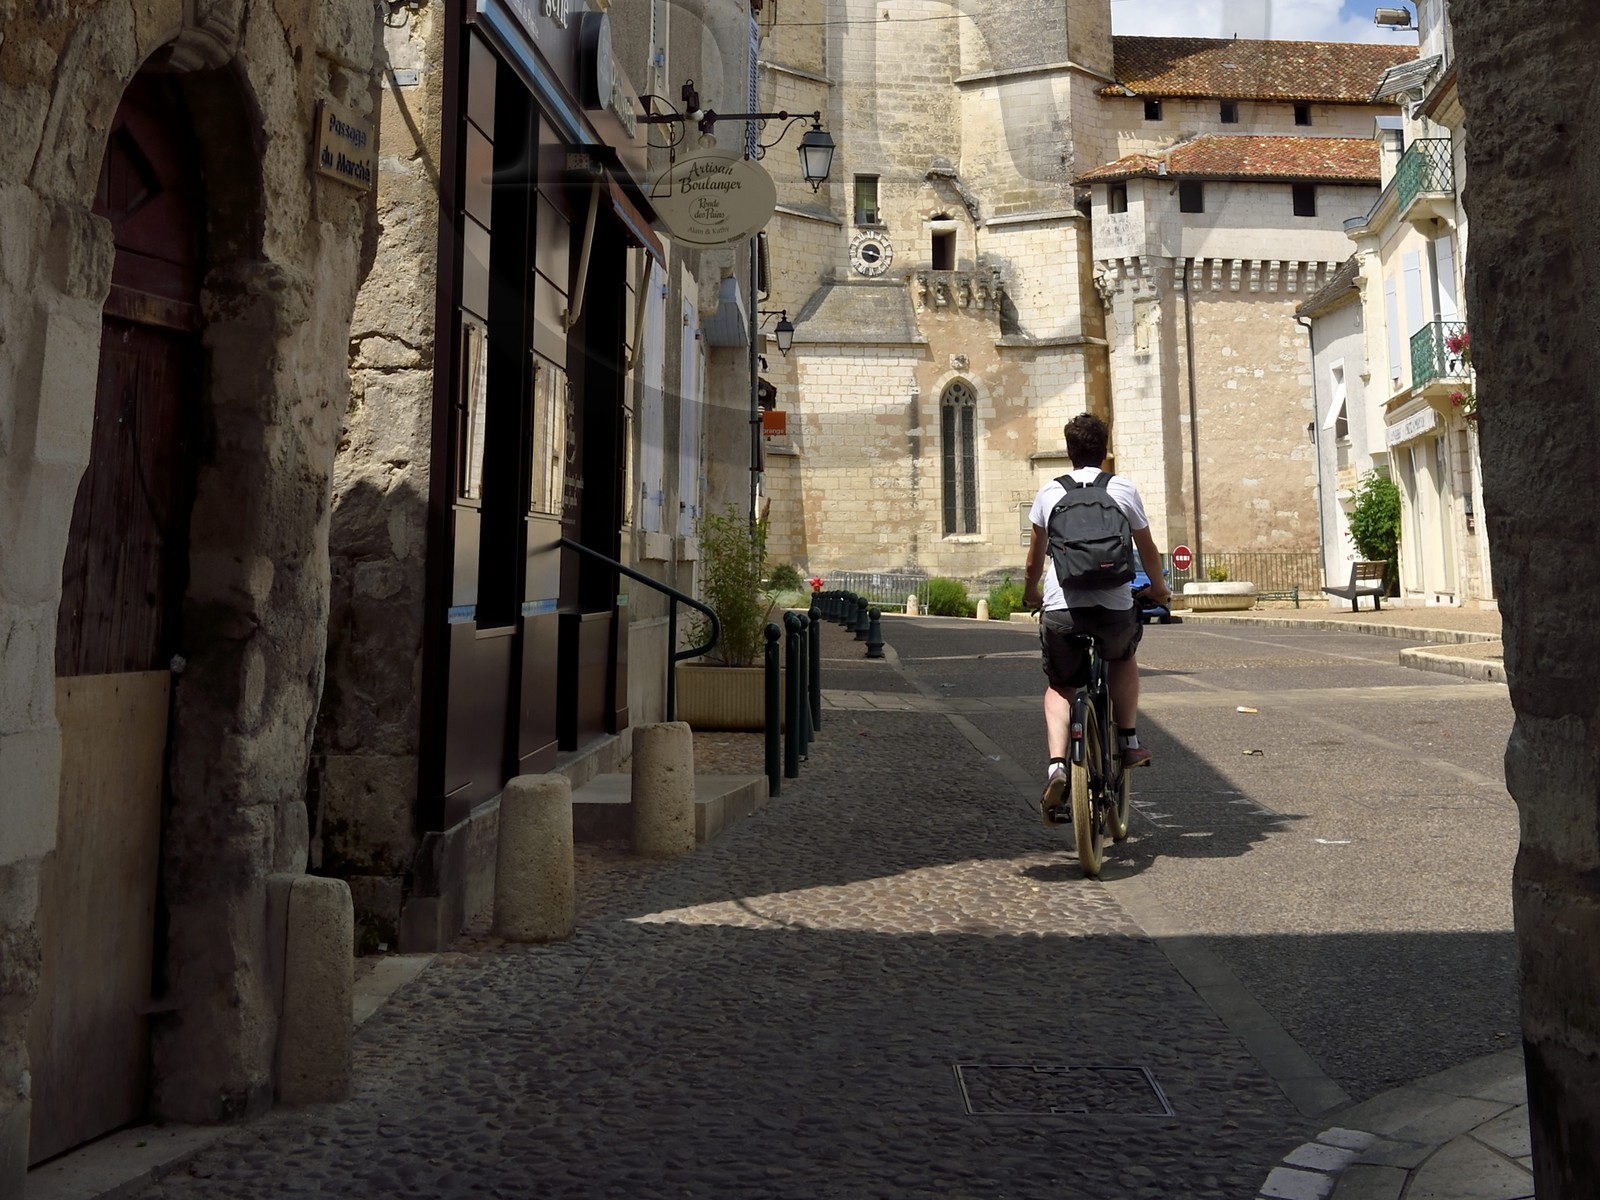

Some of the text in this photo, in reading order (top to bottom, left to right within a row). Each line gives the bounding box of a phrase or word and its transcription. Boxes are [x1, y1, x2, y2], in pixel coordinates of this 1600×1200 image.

[329, 113, 367, 148] Passage
[322, 145, 371, 182] du Marché
[689, 161, 733, 178] Artisan
[679, 176, 742, 194] Boulanger
[698, 198, 720, 209] Ronde
[694, 209, 706, 219] des
